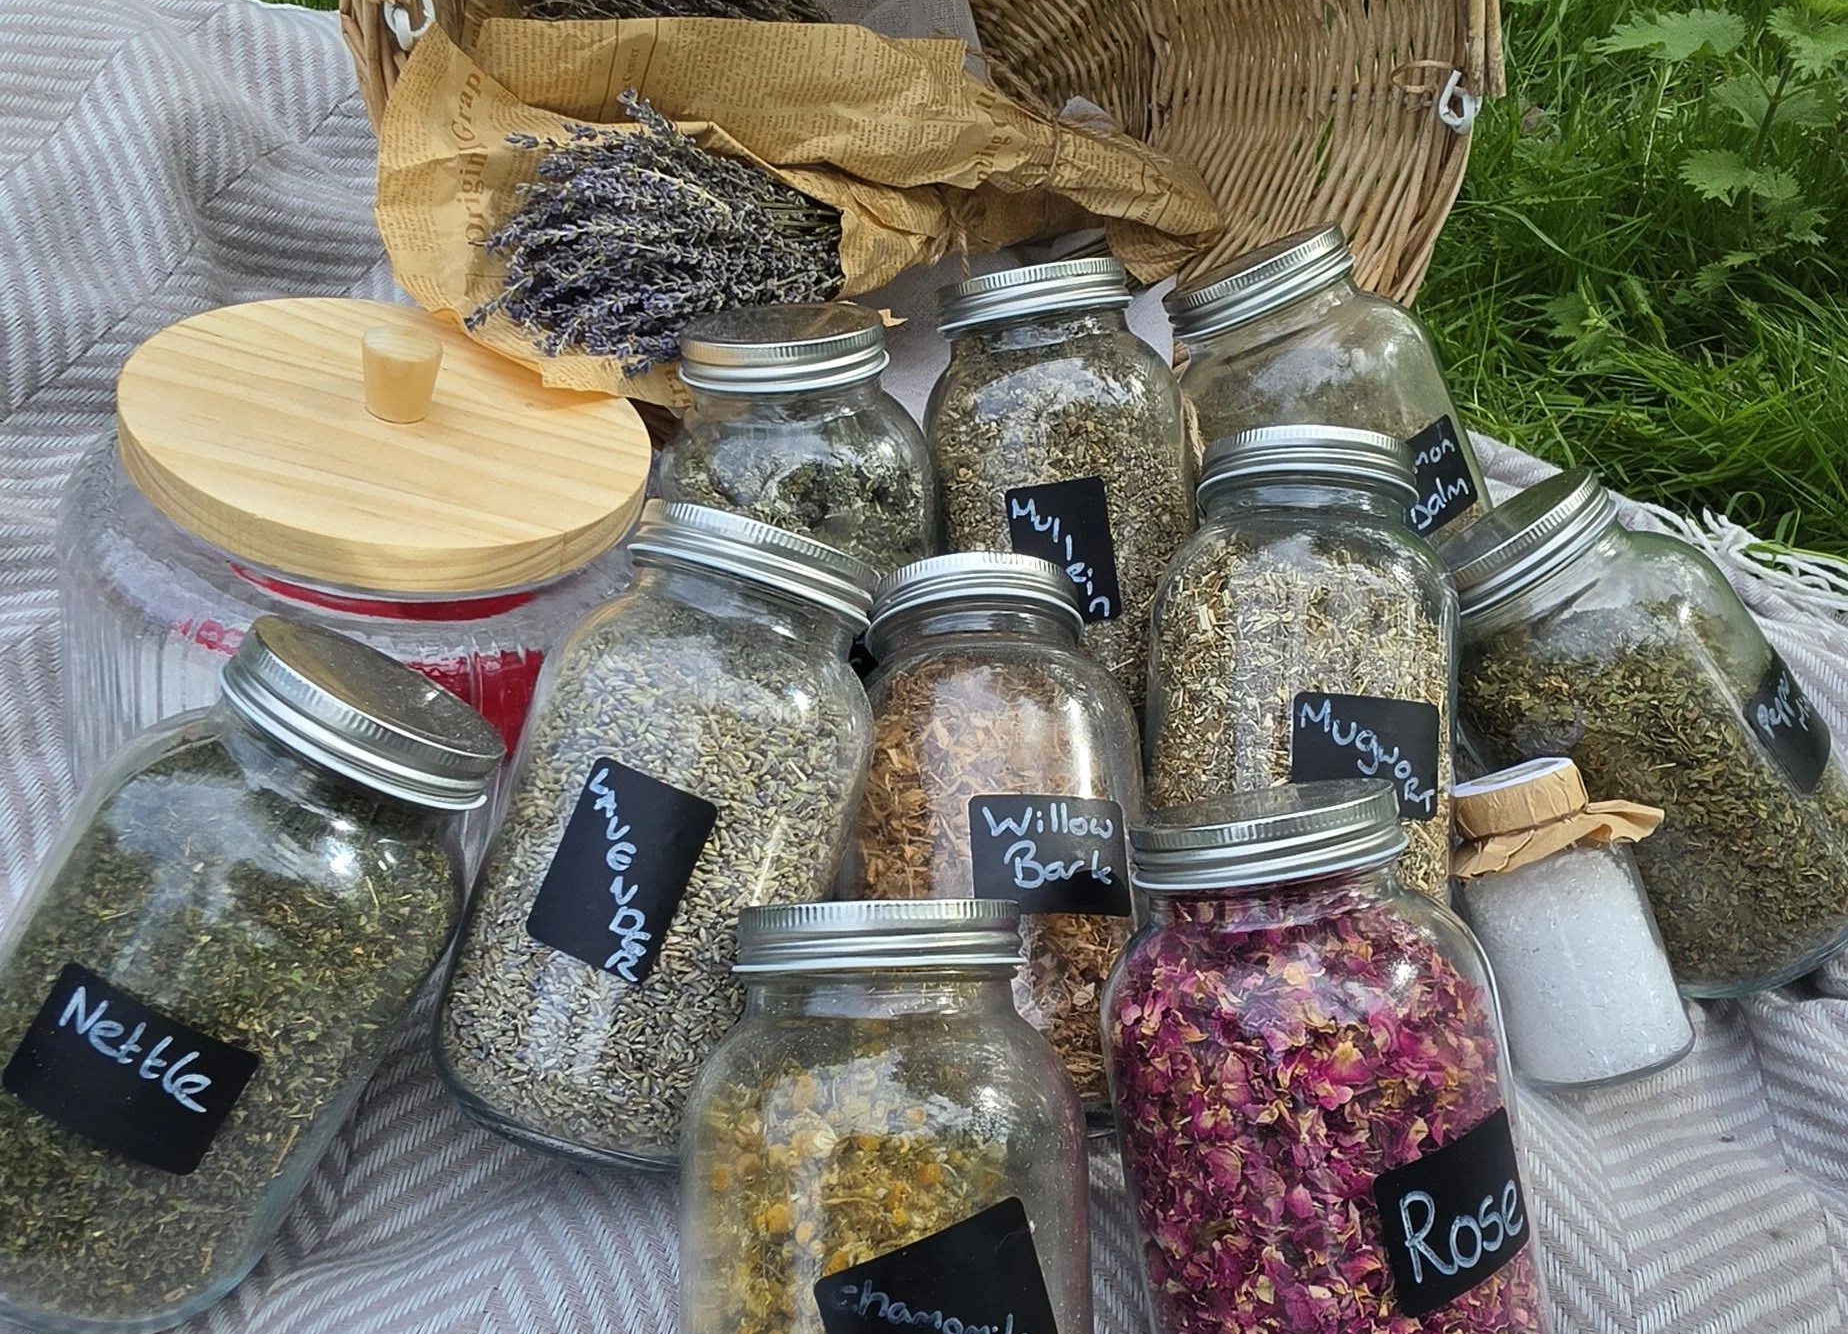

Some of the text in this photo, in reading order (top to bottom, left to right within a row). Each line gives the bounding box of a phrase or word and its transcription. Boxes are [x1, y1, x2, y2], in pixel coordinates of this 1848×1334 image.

[1413, 438, 1456, 475] mon
[1011, 497, 1111, 617] Mullein
[982, 802, 1114, 840] Willow
[1003, 839, 1113, 889] Bark
[58, 986, 212, 1113] Nettle
[1400, 1179, 1524, 1284] Rose
